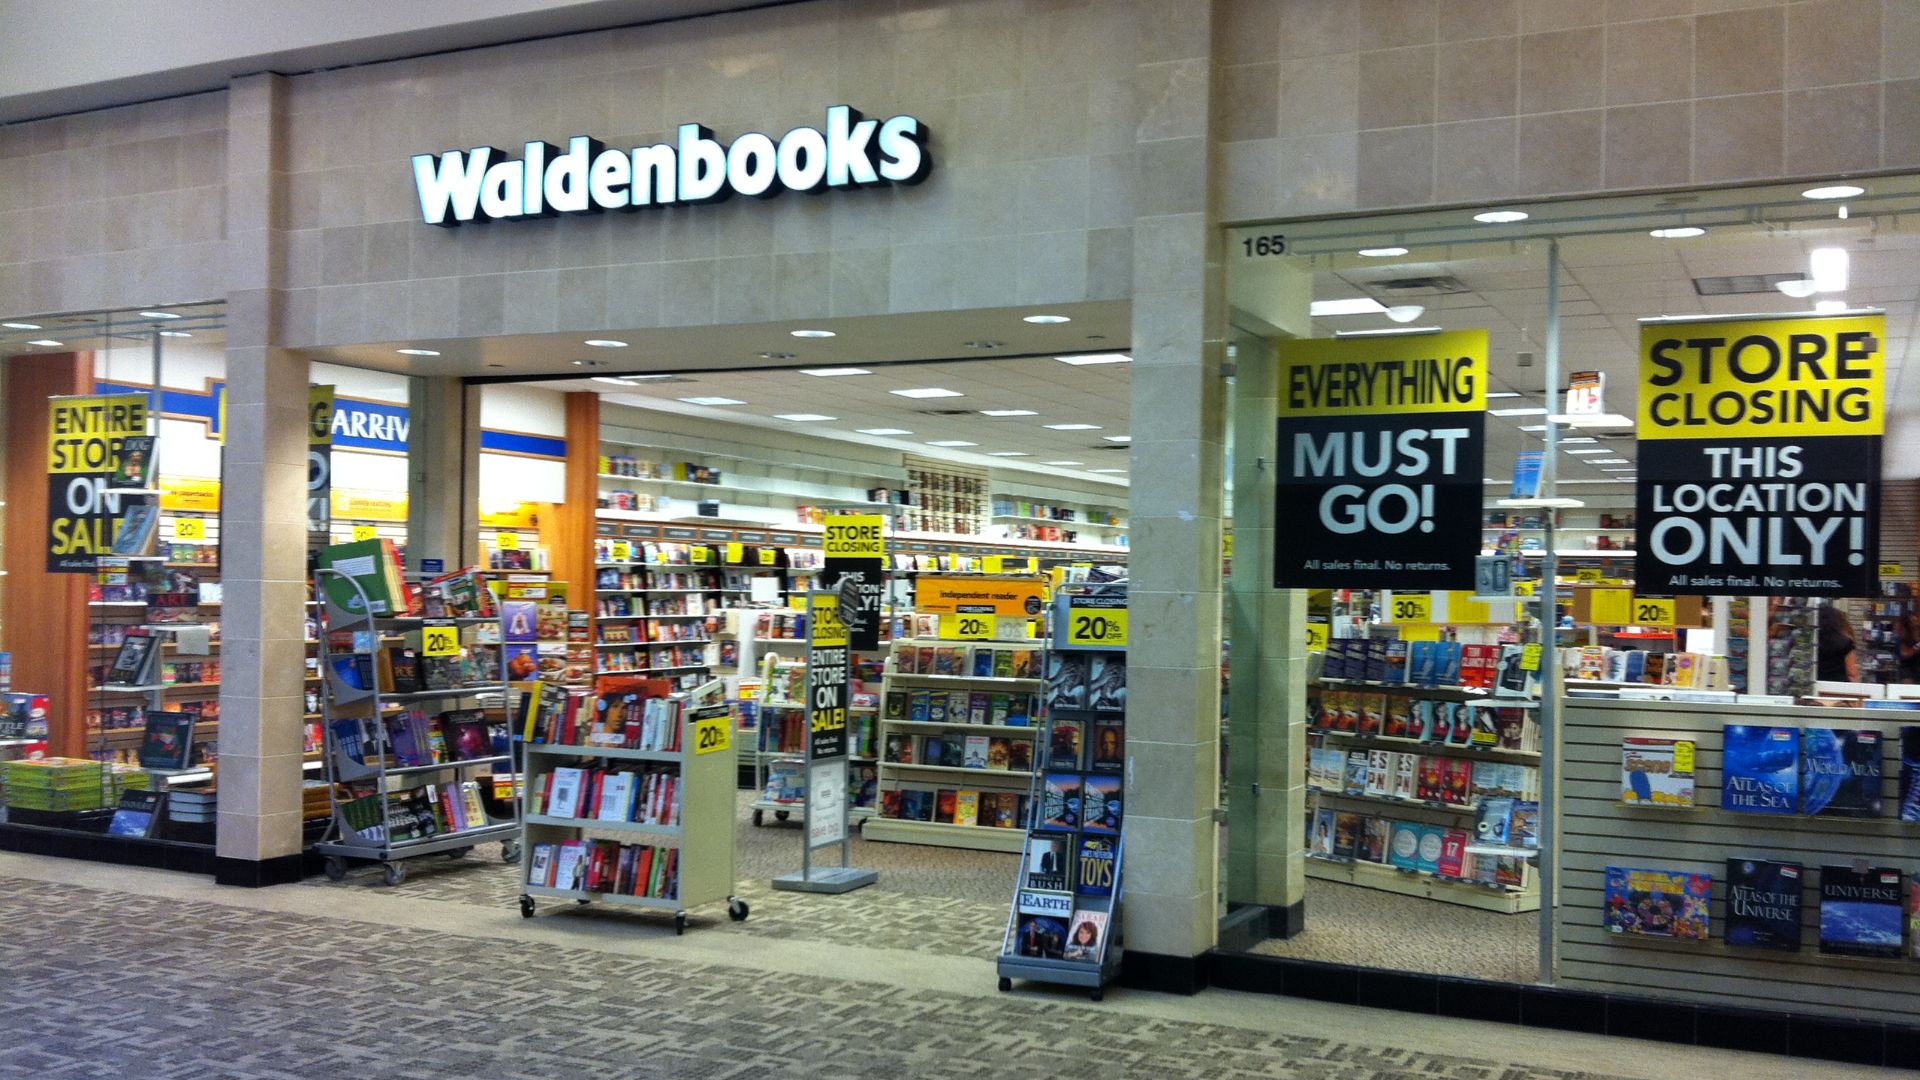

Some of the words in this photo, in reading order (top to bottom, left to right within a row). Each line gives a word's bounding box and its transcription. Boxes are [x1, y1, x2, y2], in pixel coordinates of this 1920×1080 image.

[411, 104, 924, 225] Waldenbooks
[1243, 235, 1285, 257] 165
[1648, 330, 1872, 387] STORE
[1289, 357, 1474, 409] EVERYTHING
[54, 403, 144, 434] ENTIRE
[1650, 387, 1870, 426] CLOSING
[331, 408, 410, 443] ARRIV
[52, 437, 125, 469] STOR
[1293, 427, 1470, 477] MUST
[1703, 445, 1805, 478] THIS
[66, 477, 121, 515] ON
[1319, 483, 1436, 534] GO!
[1653, 483, 1866, 513] LOCATION
[826, 525, 881, 541] STORE
[1650, 515, 1866, 566] ONLY!
[826, 541, 881, 553] CLOSING
[838, 571, 865, 582] THIS
[1304, 560, 1320, 570] All
[1322, 560, 1350, 570] sales
[1353, 560, 1382, 570] final.
[1385, 560, 1403, 570] No
[1406, 560, 1451, 570] returns.
[1669, 576, 1689, 586] All
[1691, 576, 1724, 586] sales
[1727, 576, 1760, 586] final.
[1764, 576, 1785, 586] No
[1788, 577, 1844, 587] returns.
[811, 607, 839, 624] STOR
[811, 649, 846, 666] ENTIRE
[810, 666, 846, 686] STORE
[816, 686, 838, 708] ON
[811, 707, 845, 733] SALE!
[1447, 841, 1459, 856] 17
[1030, 879, 1063, 890] BUSH
[1079, 857, 1112, 887] TOYS
[1021, 893, 1070, 911] EARTH
[1824, 885, 1898, 900] UNIVERSE
